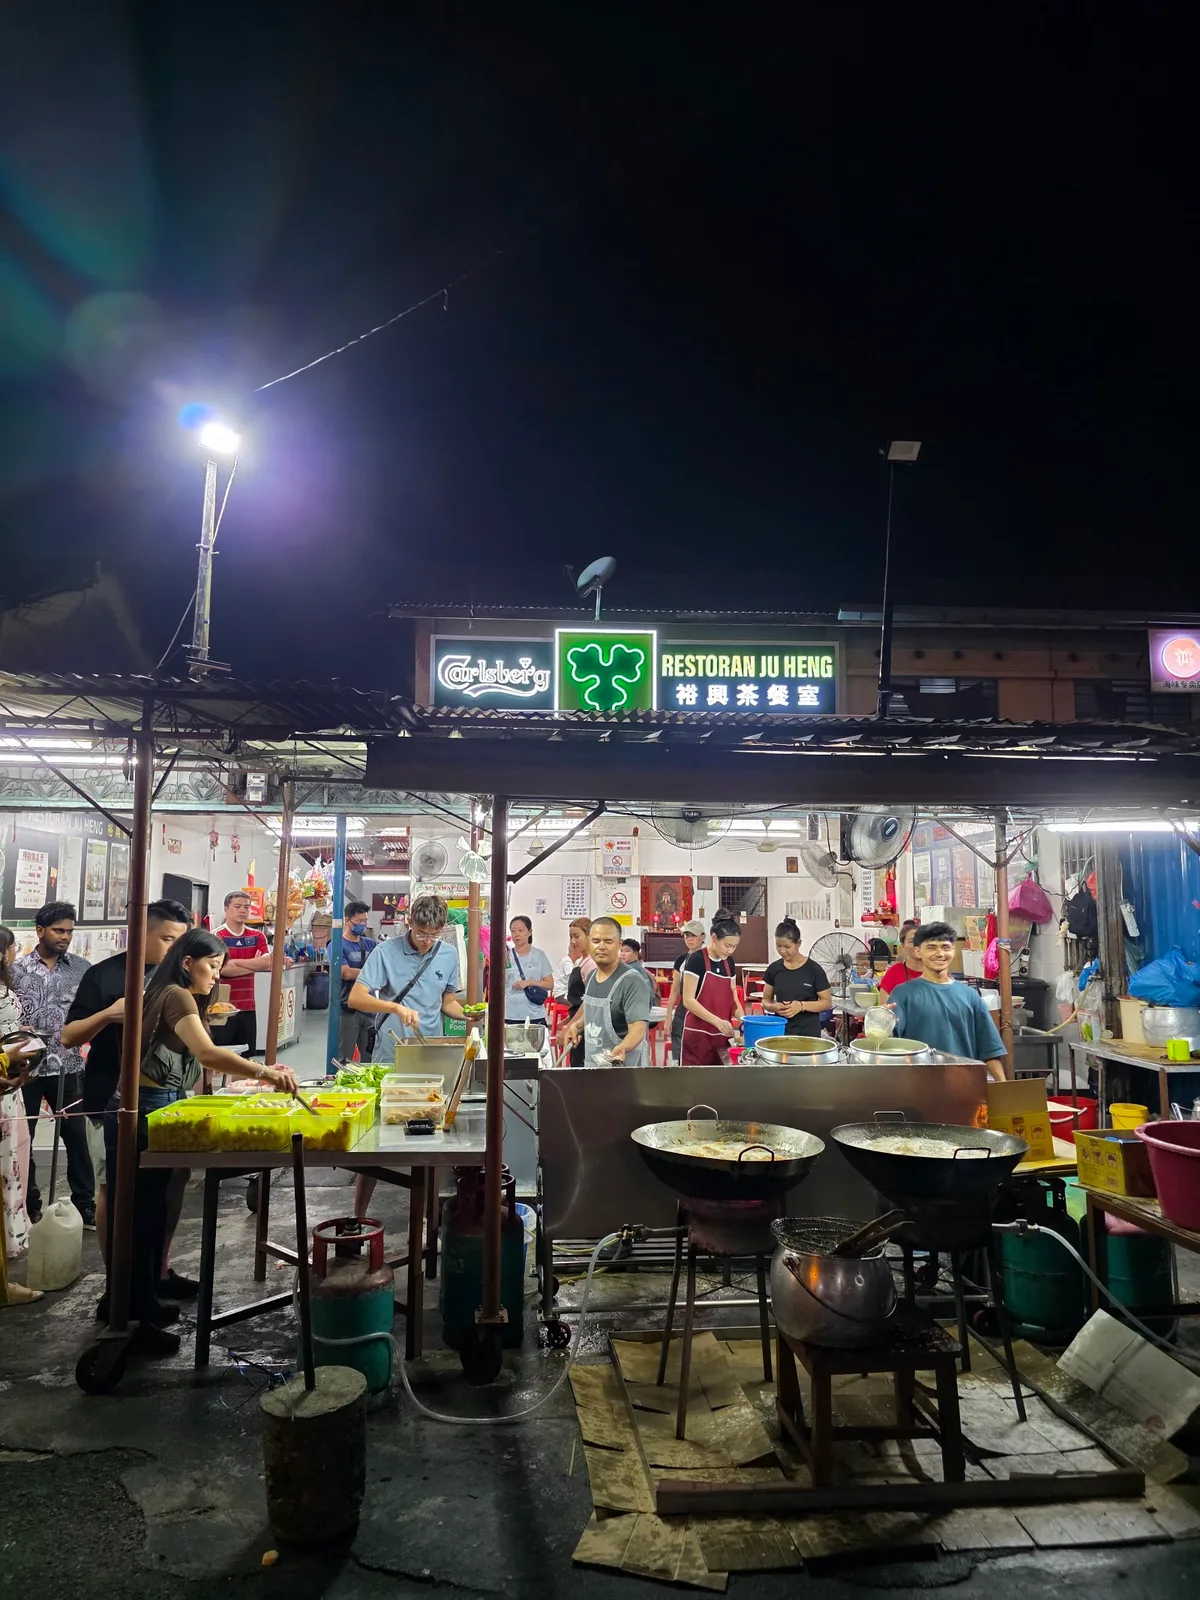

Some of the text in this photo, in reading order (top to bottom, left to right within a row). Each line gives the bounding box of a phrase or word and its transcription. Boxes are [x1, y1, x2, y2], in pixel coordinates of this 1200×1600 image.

[438, 655, 551, 696] Carlsberg
[662, 655, 833, 678] RESTORAN JU HENG
[676, 684, 819, 706] 裕興茶餐室
[84, 819, 103, 836] HENG
